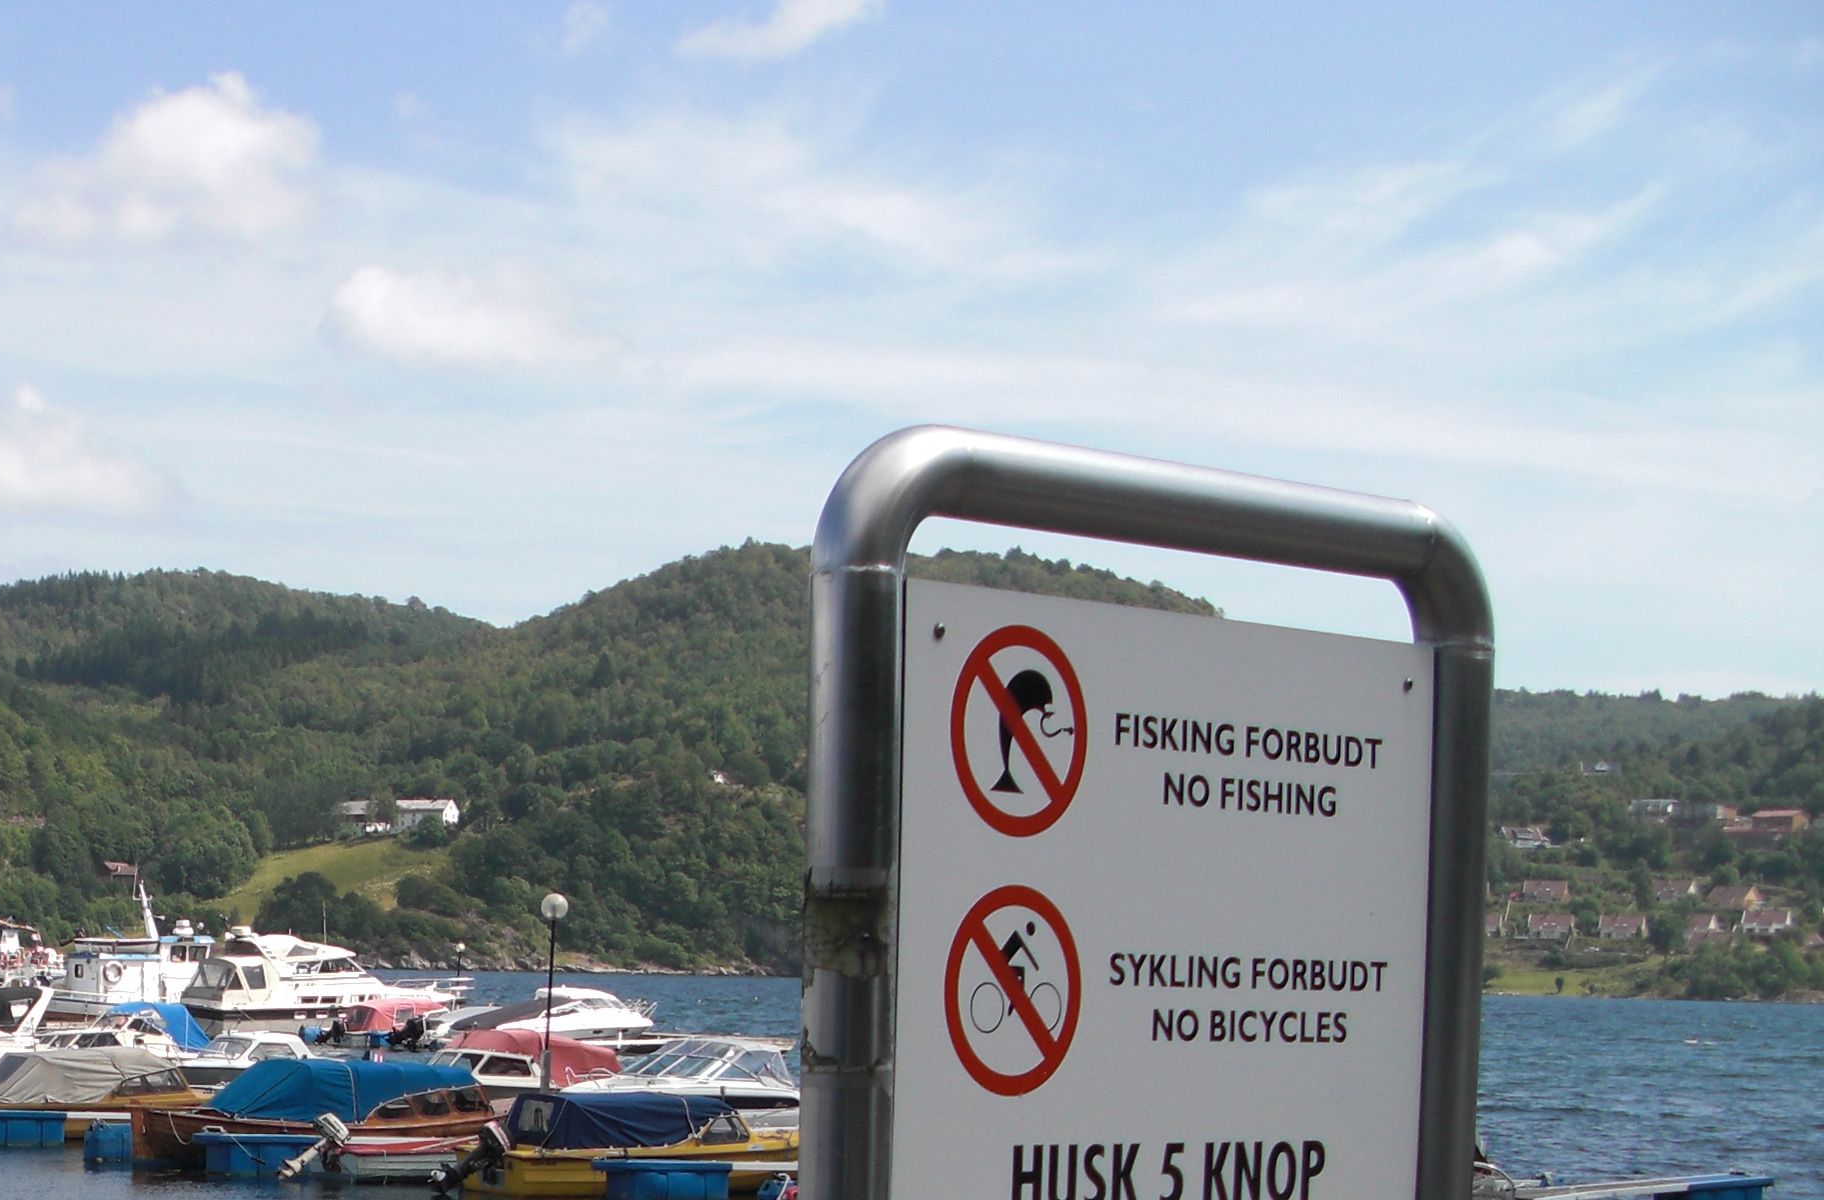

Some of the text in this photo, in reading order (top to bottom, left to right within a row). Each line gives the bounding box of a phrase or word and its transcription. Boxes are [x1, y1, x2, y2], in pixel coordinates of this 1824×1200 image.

[1114, 712, 1384, 771] FISKING FORBUDT
[1162, 771, 1338, 819] NO FISHING
[1109, 951, 1389, 993] SYKLING FORBUDT
[1150, 1008, 1349, 1044] NO BICYCLES
